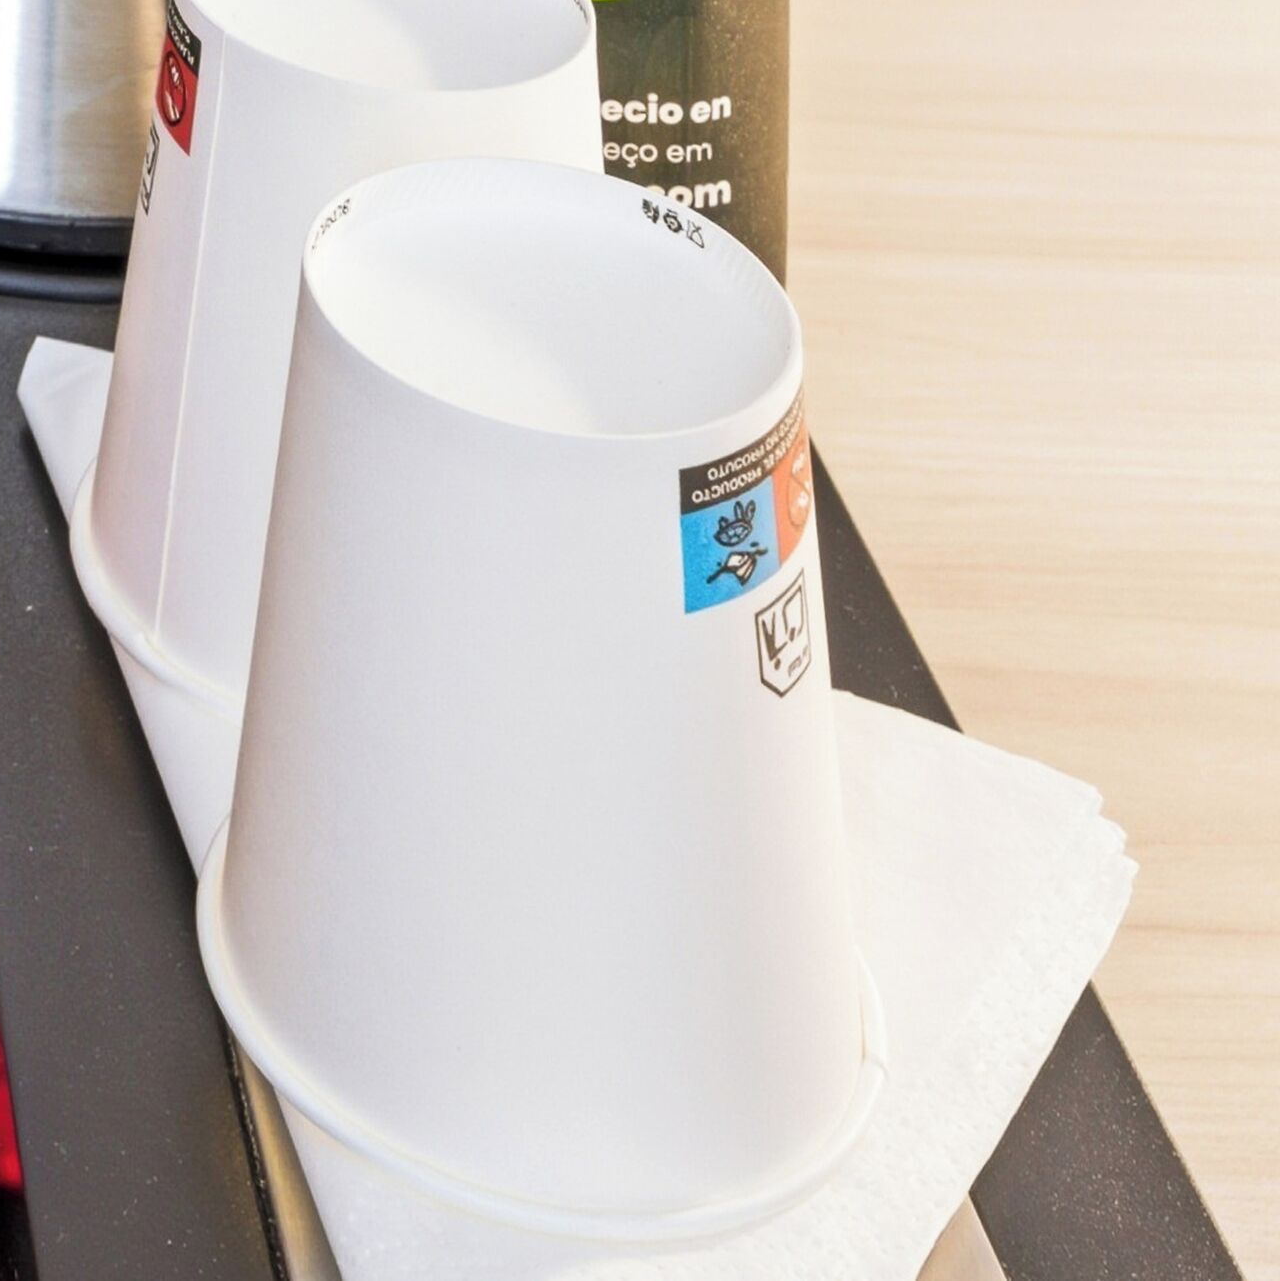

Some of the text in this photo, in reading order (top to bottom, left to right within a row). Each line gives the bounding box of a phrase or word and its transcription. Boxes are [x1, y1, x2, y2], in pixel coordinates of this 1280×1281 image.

[601, 92, 733, 125] ecio en
[603, 141, 713, 169] eço em
[690, 466, 763, 504] PRODUCTO
